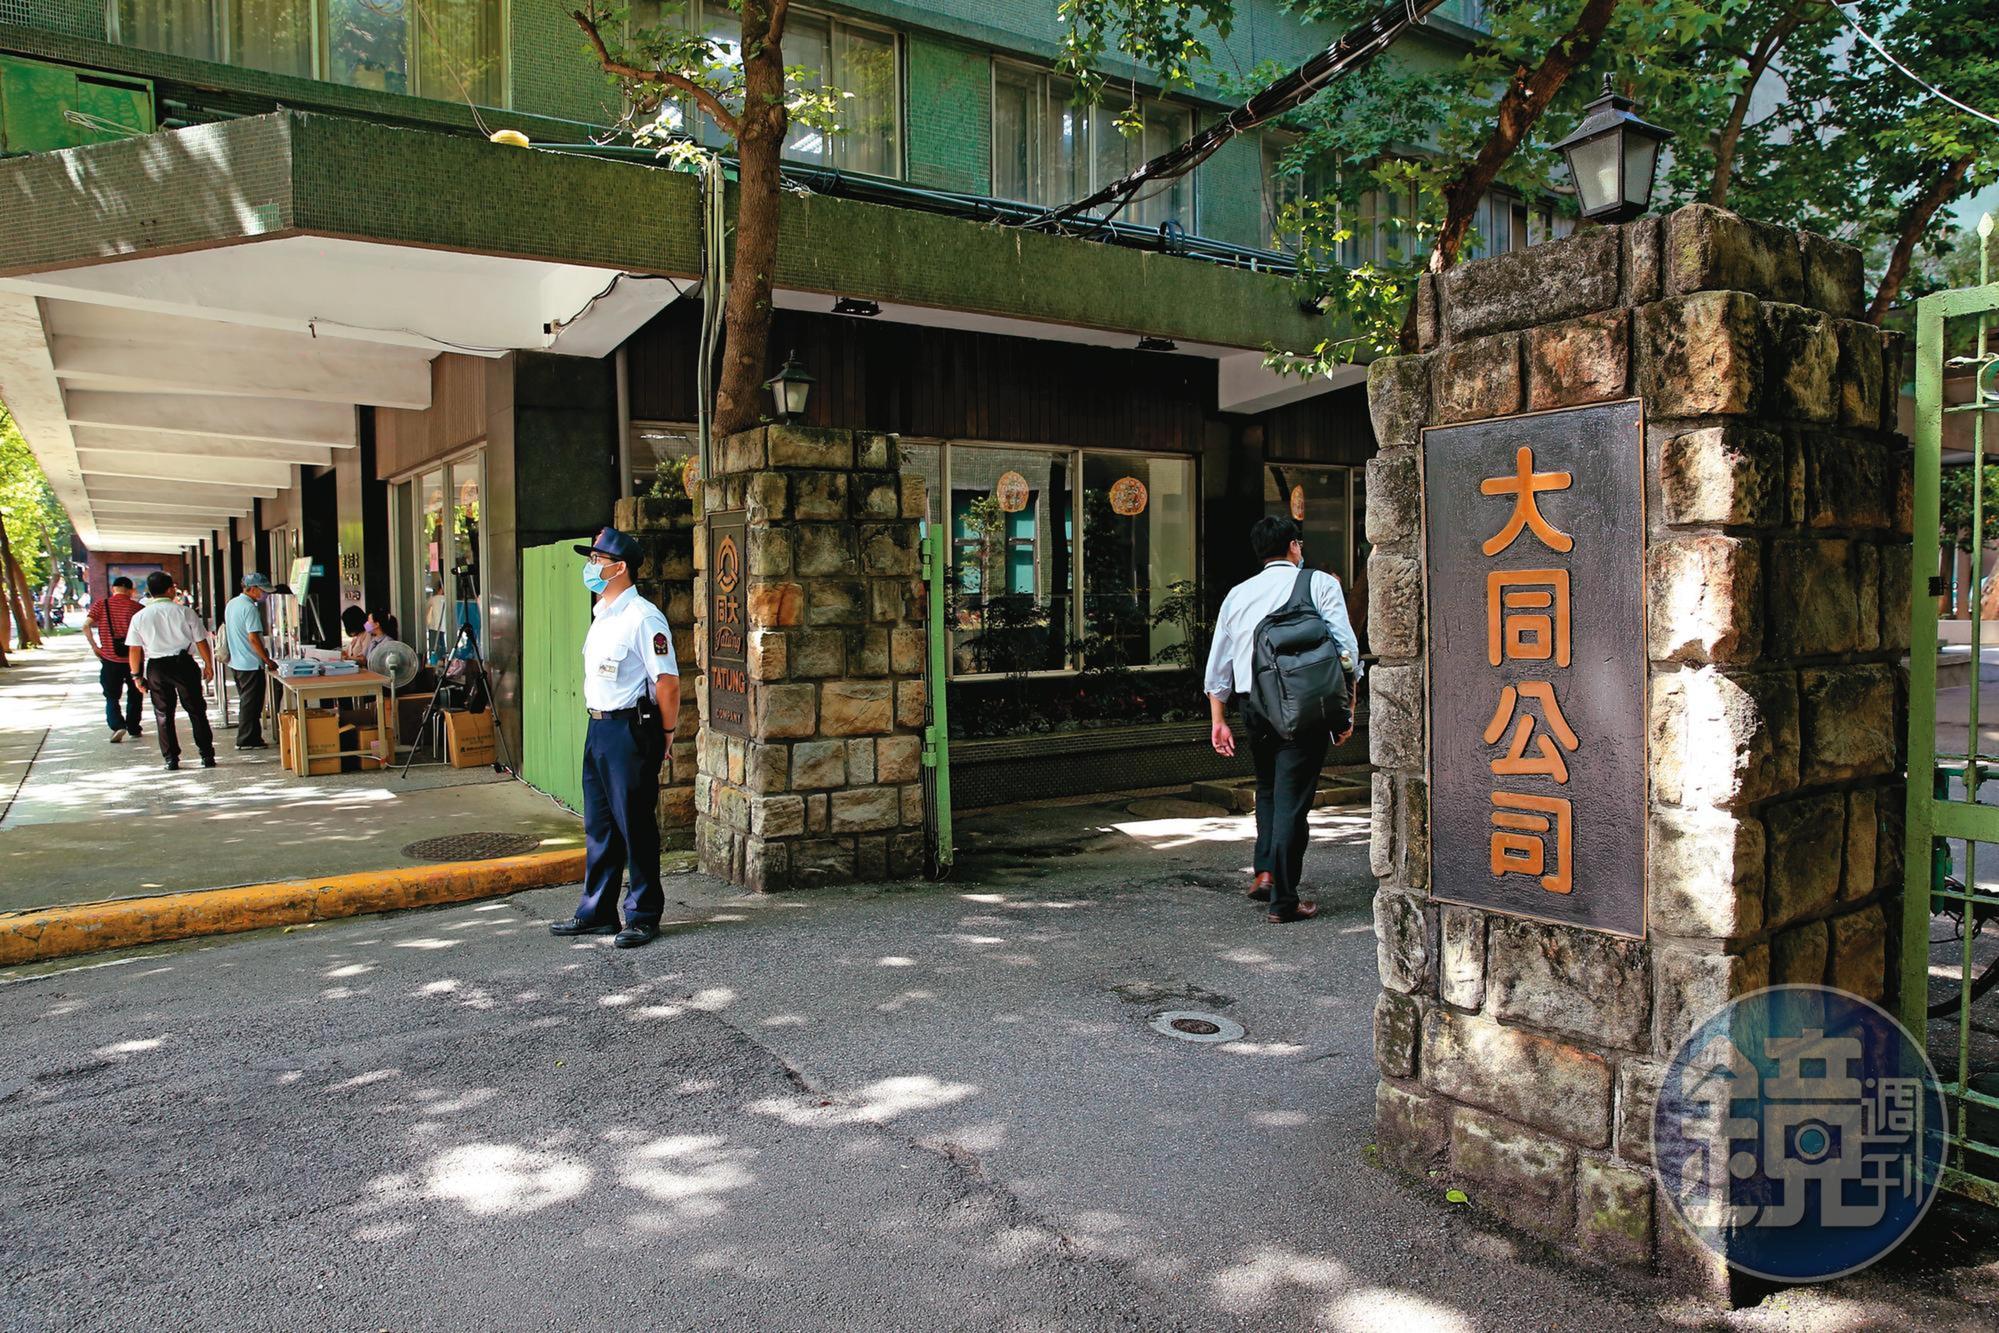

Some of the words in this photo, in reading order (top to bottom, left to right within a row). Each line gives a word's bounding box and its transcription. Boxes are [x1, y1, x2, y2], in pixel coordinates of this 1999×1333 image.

[712, 666, 745, 693] TATUNG
[1480, 446, 1579, 895] 大同公司
[716, 708, 743, 724] COMPANY
